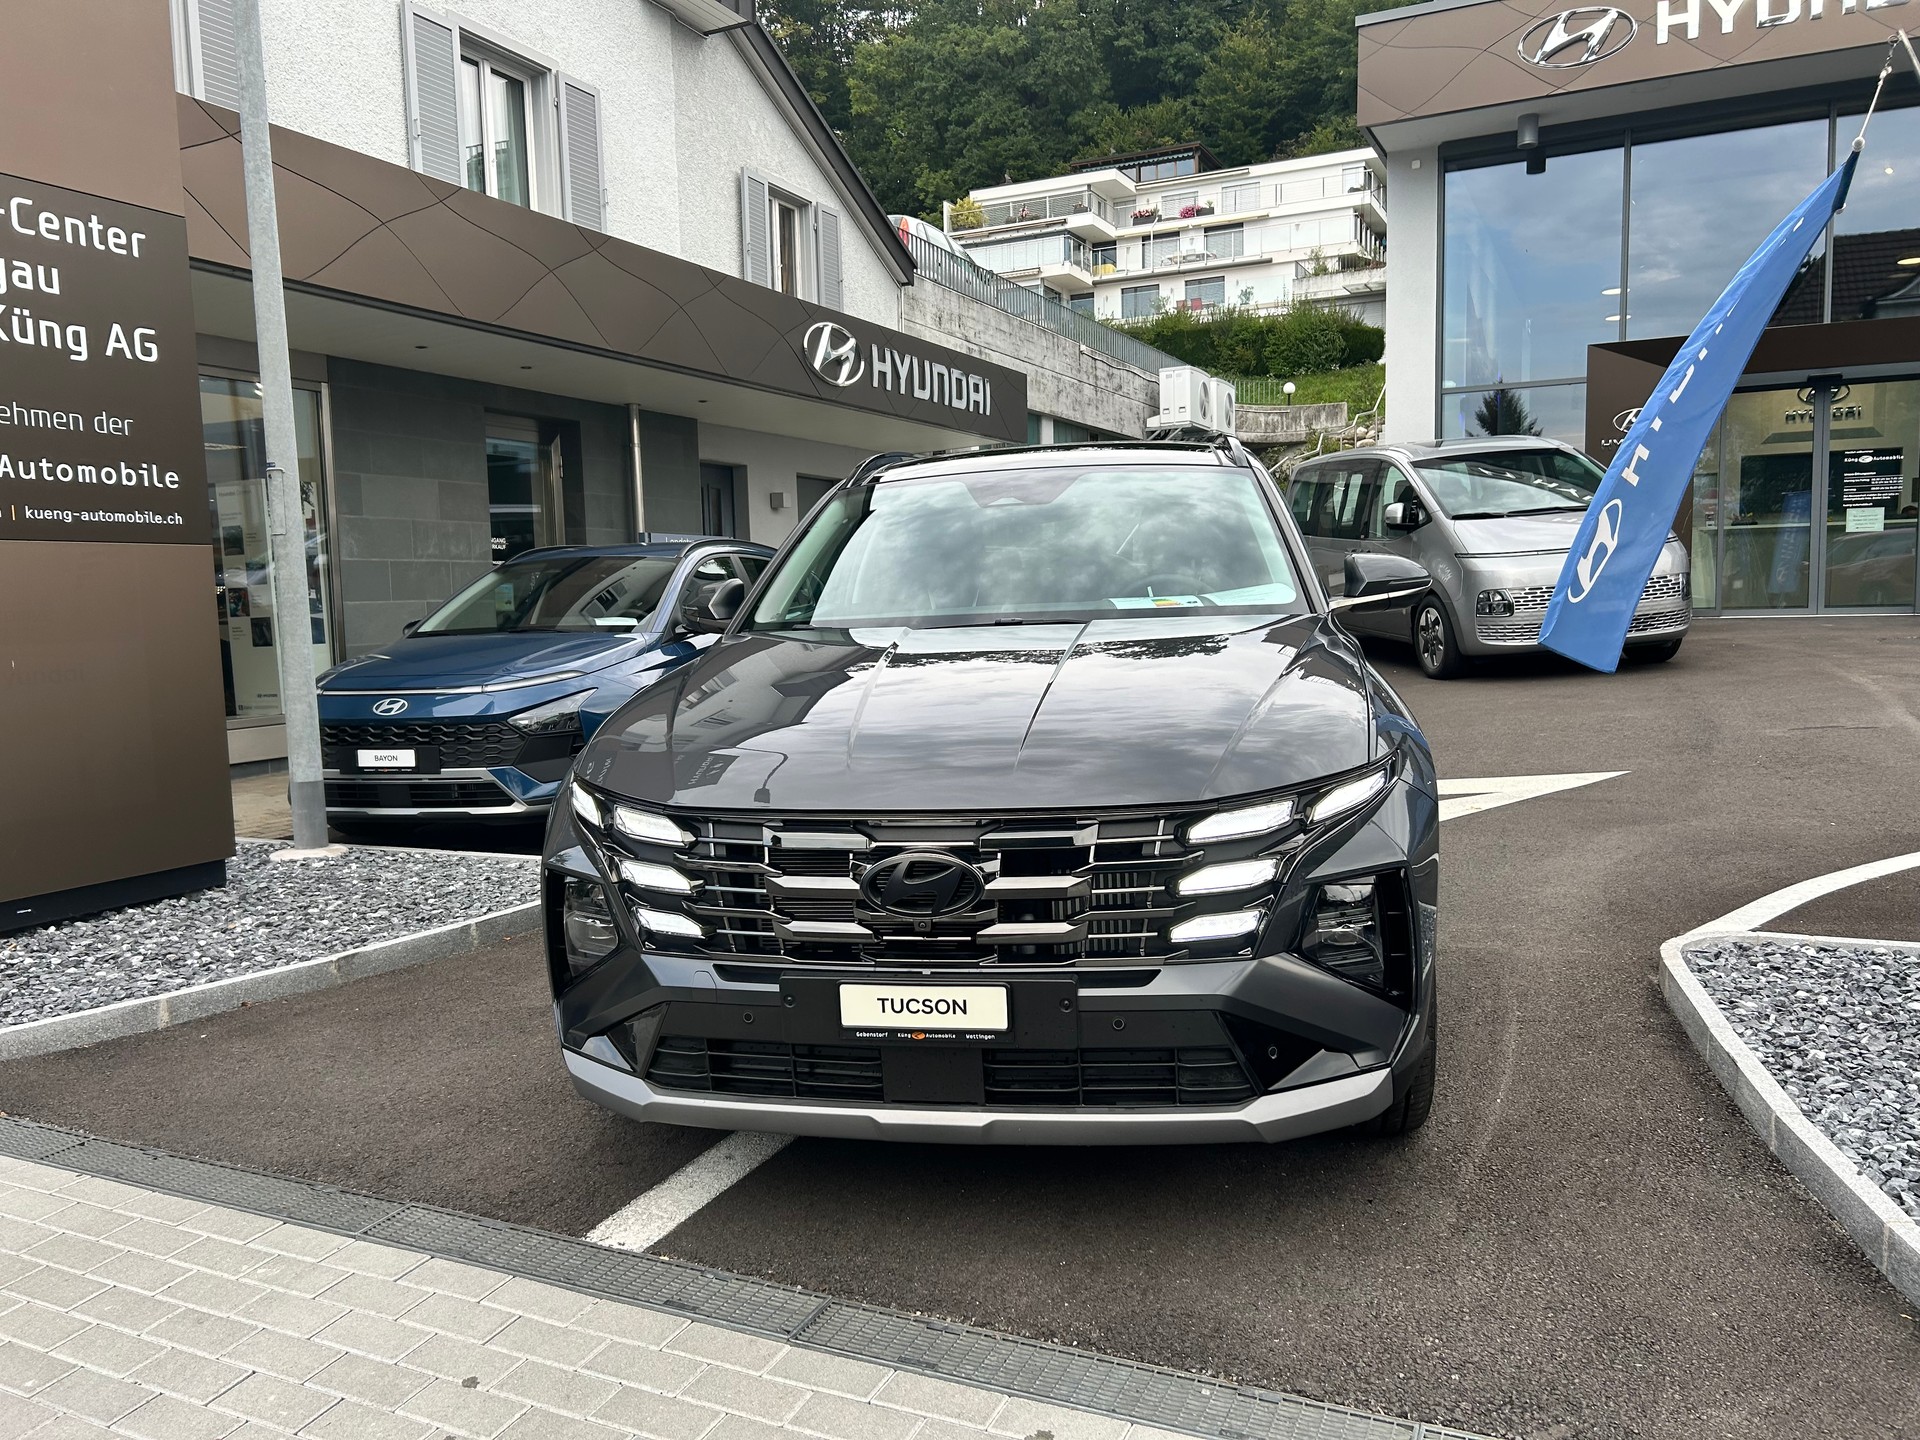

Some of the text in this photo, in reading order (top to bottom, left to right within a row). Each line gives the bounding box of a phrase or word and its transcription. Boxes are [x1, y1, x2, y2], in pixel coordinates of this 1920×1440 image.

[105, 322, 158, 363] AG
[871, 343, 991, 416] HYUNDAI
[93, 410, 134, 436] der
[0, 454, 179, 489] Automobile
[24, 505, 183, 525] kueng-automobile.ch
[374, 754, 399, 762] BAYON
[877, 997, 968, 1016] TUCSON
